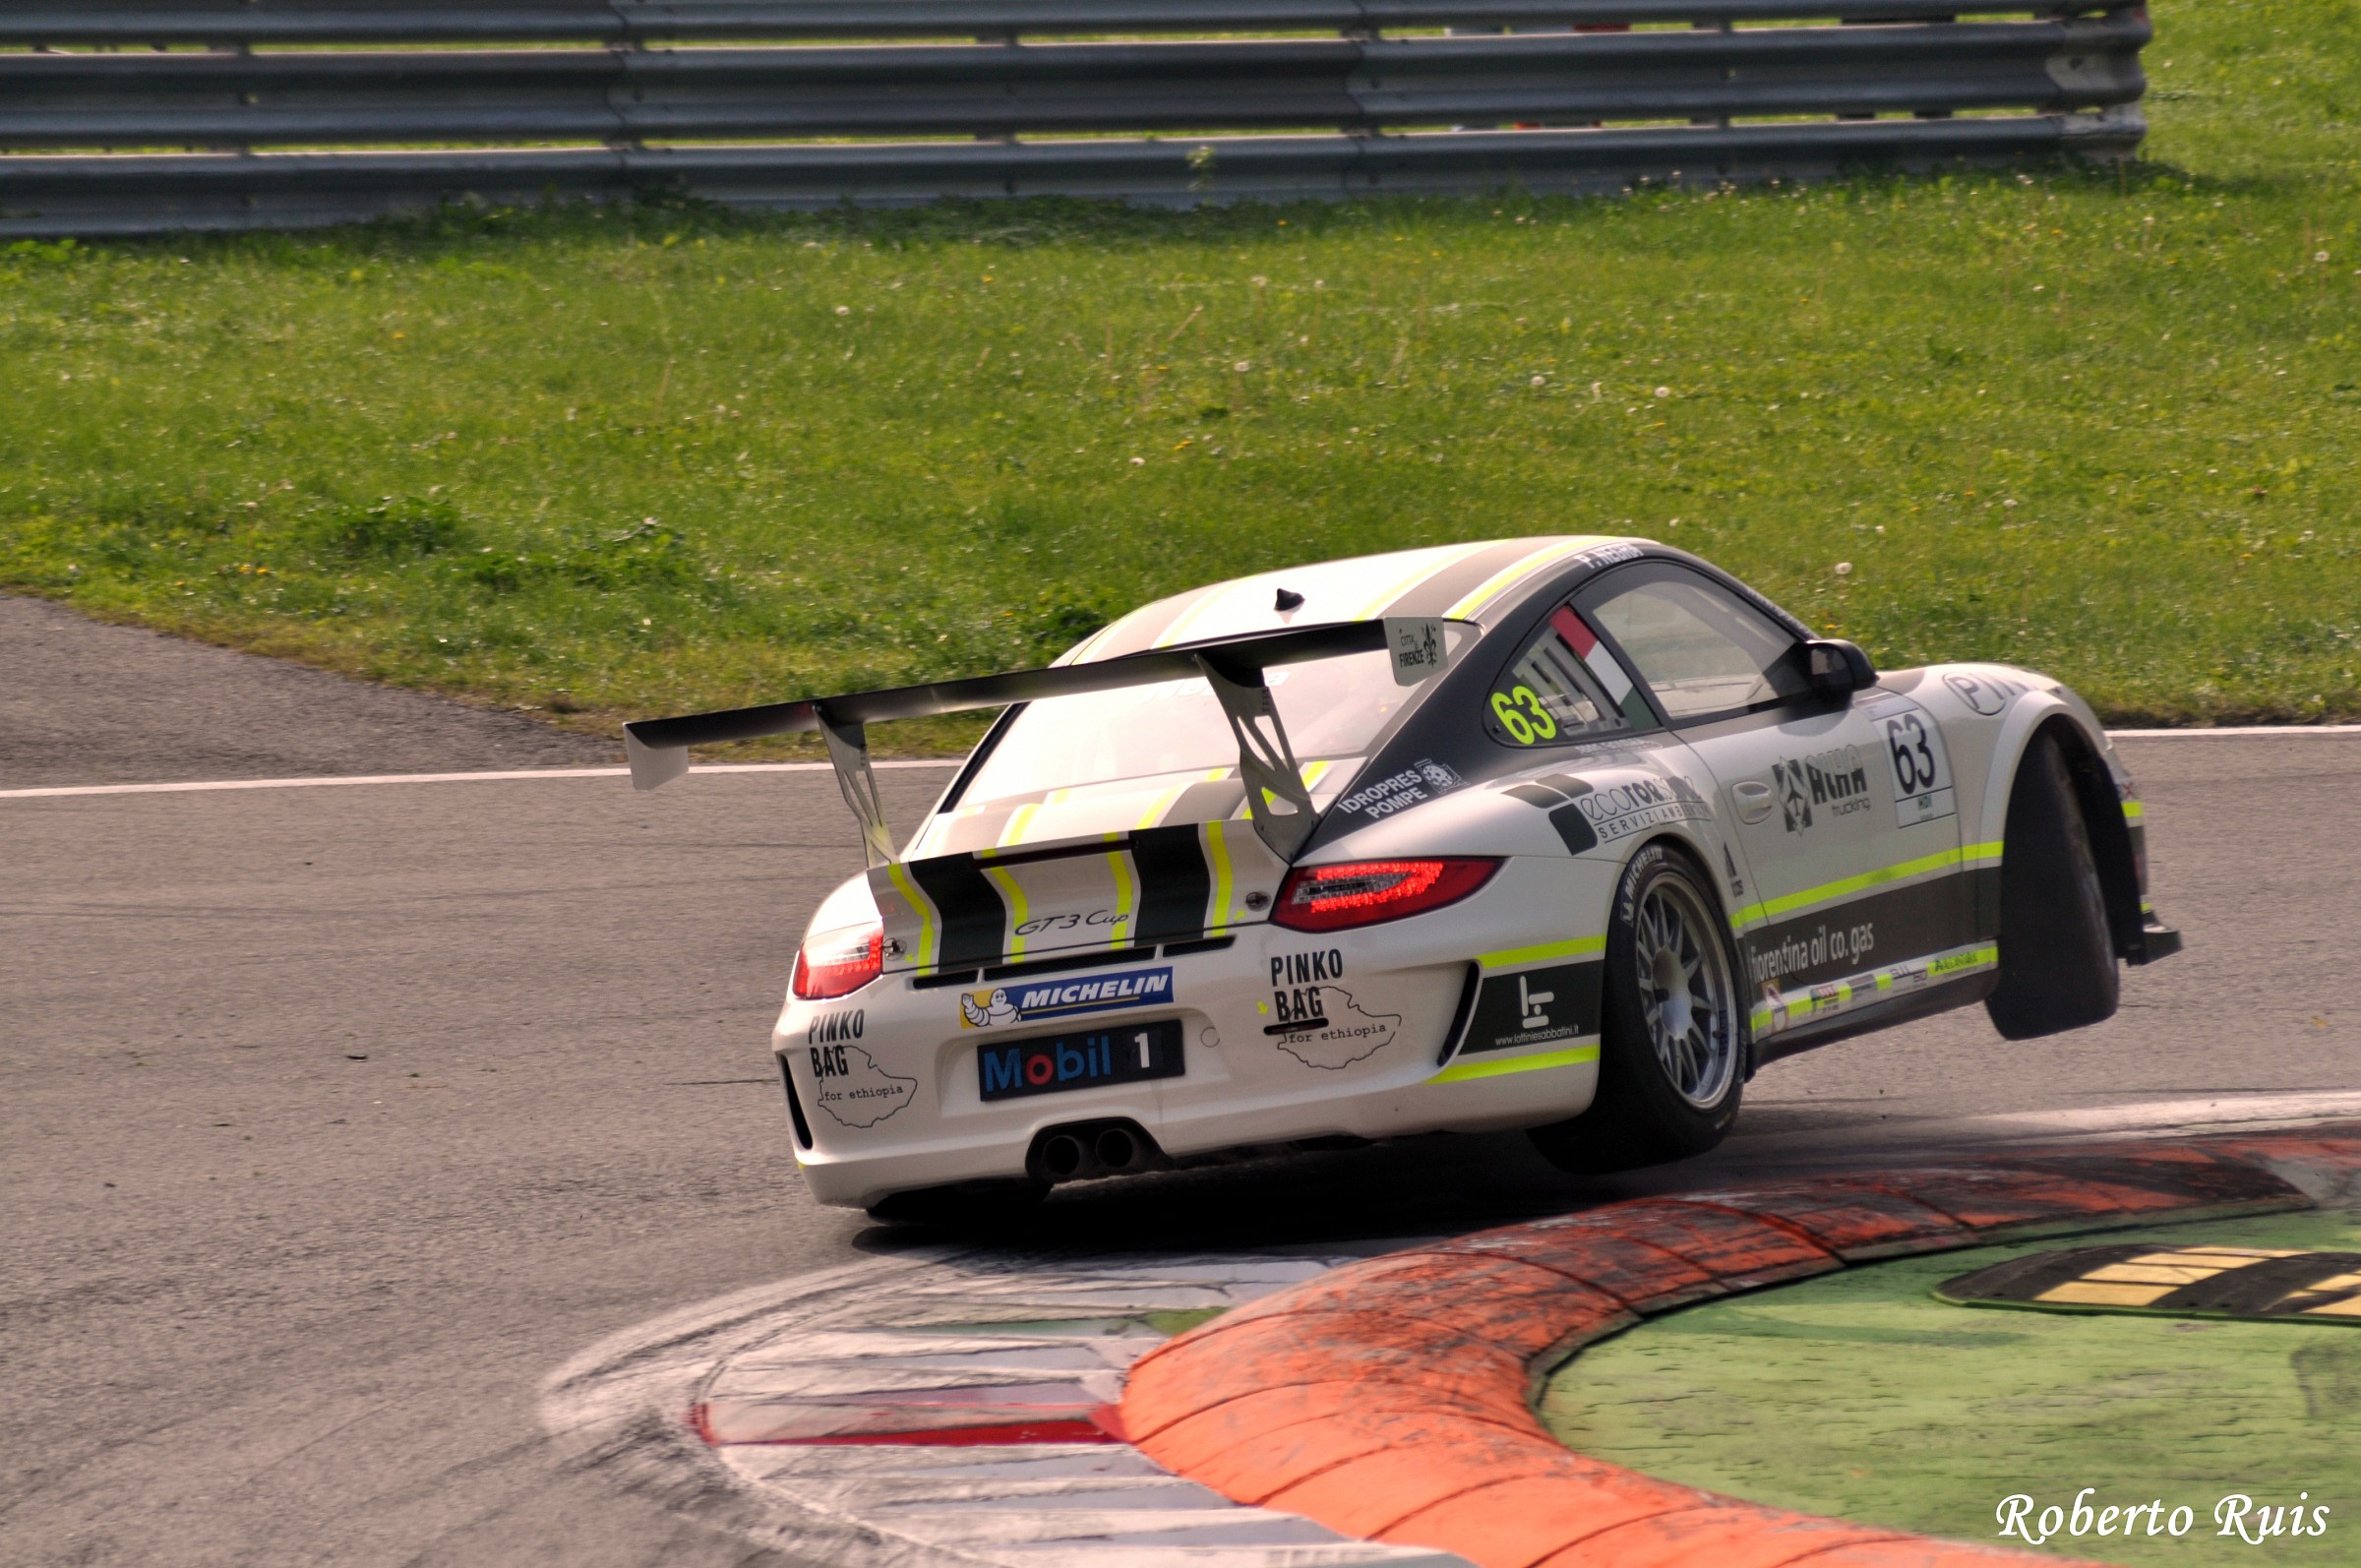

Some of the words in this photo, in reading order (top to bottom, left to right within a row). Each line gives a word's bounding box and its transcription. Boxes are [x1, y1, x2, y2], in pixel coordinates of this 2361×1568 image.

[1399, 649, 1424, 668] FIRENZE
[1490, 686, 1556, 745] 63
[1886, 713, 1936, 795] 63
[1338, 770, 1423, 814] IDROPRES
[1365, 788, 1427, 818] POMPE
[1832, 797, 1871, 817] trucking
[1598, 813, 1660, 838] SERVIZI
[1086, 910, 1128, 928] Cup
[1811, 925, 1828, 966] oil
[1831, 930, 1848, 960] co.
[1851, 923, 1874, 965] gas
[1271, 948, 1343, 987] PINKO
[1021, 974, 1168, 1009] MICHELIN
[1274, 987, 1324, 1022] BAG
[809, 1009, 865, 1045] PINKO
[1289, 1034, 1312, 1043] for
[1320, 1023, 1386, 1040] ethiopia
[810, 1045, 849, 1077] BAG
[985, 1035, 1111, 1093] Mobil
[1133, 1033, 1150, 1068] 1
[824, 1092, 842, 1101] for
[849, 1084, 903, 1099] ethiopia
